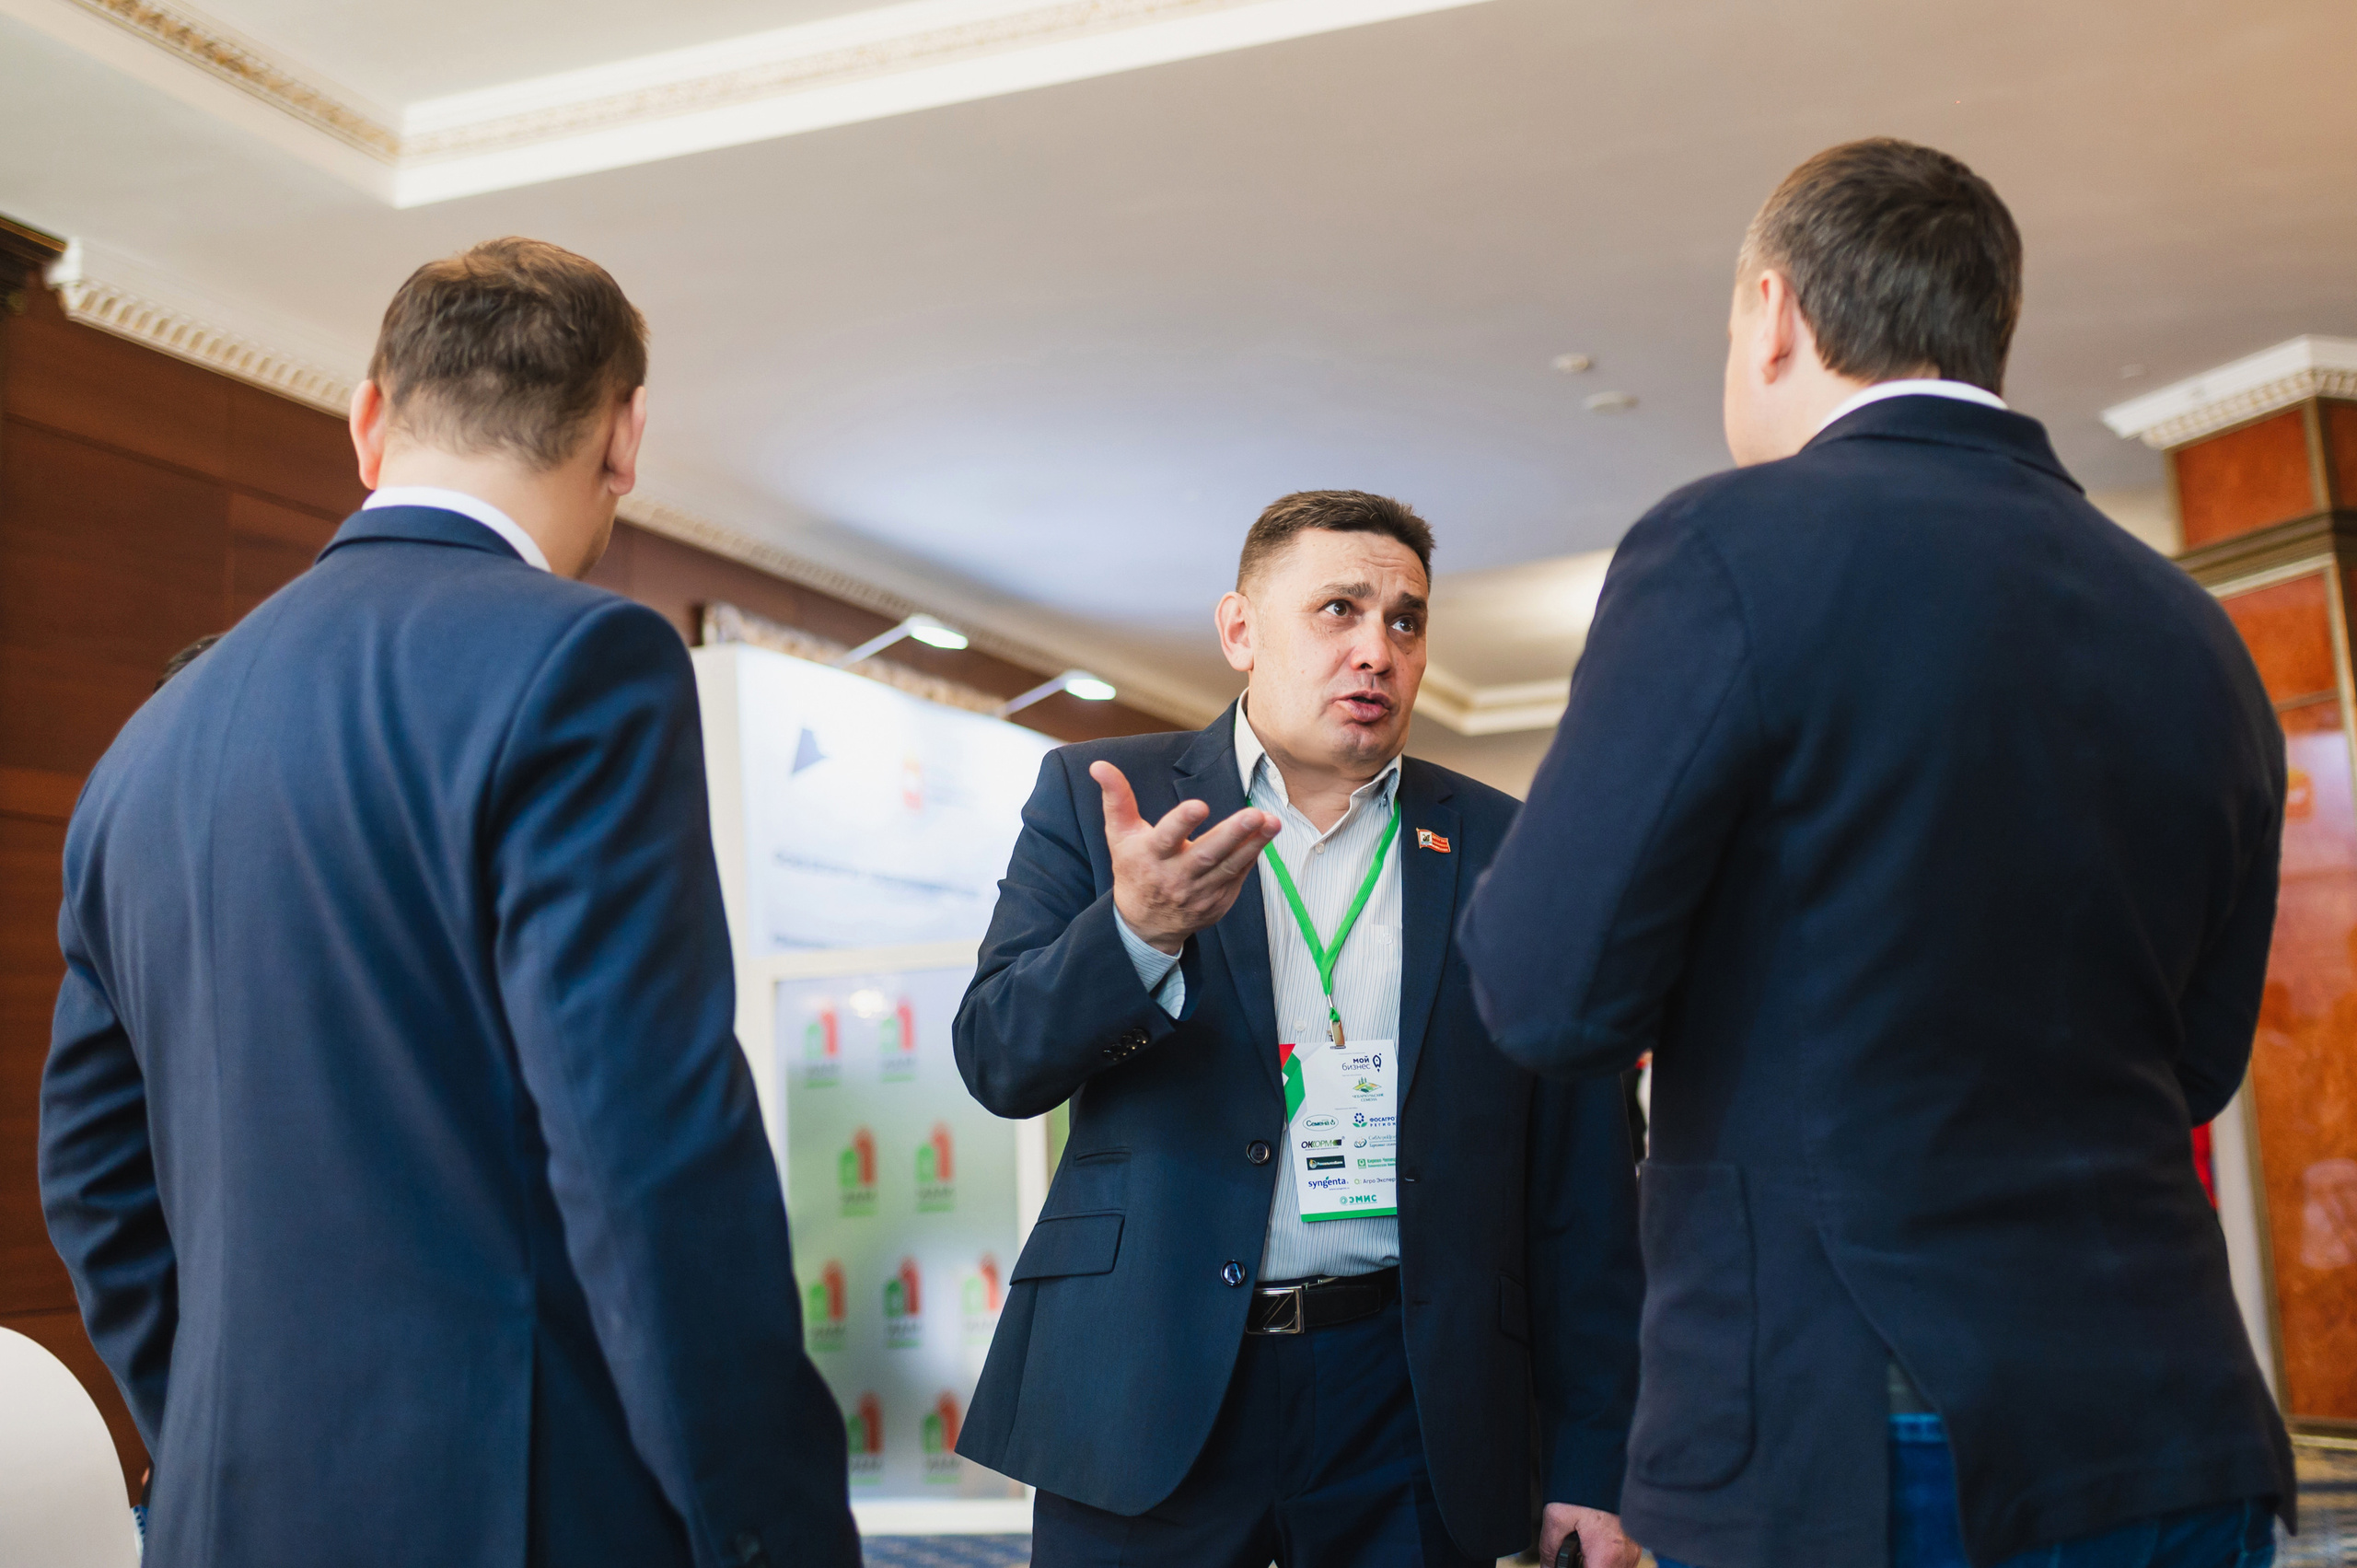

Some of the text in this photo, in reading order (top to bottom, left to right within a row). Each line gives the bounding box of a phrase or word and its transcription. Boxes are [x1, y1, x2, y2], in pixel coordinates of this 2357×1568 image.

[1353, 1055, 1370, 1063] мой
[1341, 1063, 1371, 1071] бизнес
[1307, 1178, 1346, 1190] syngenta
[1349, 1194, 1377, 1203] ЭМИС
